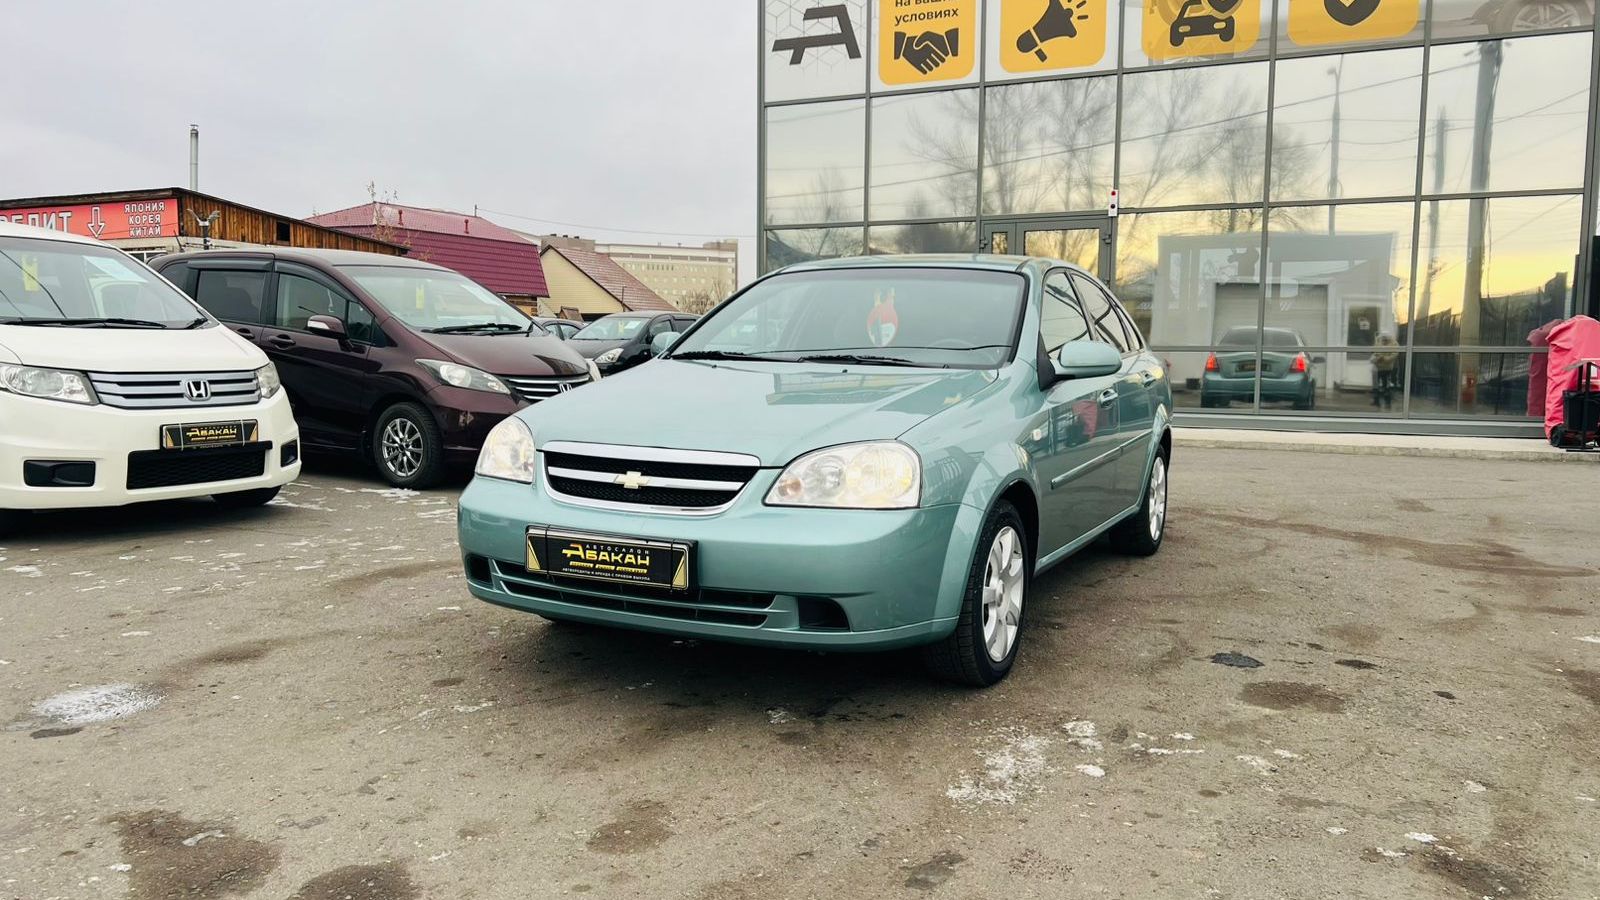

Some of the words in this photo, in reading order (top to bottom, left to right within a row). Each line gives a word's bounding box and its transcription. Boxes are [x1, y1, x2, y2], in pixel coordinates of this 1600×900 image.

[894, 8, 959, 27] условиях
[124, 202, 165, 213] ЯПОНИЯ
[129, 214, 161, 224] КОРЕЯ
[129, 224, 161, 236] КИТАЙ
[586, 544, 649, 555] АВТОСАЛОН
